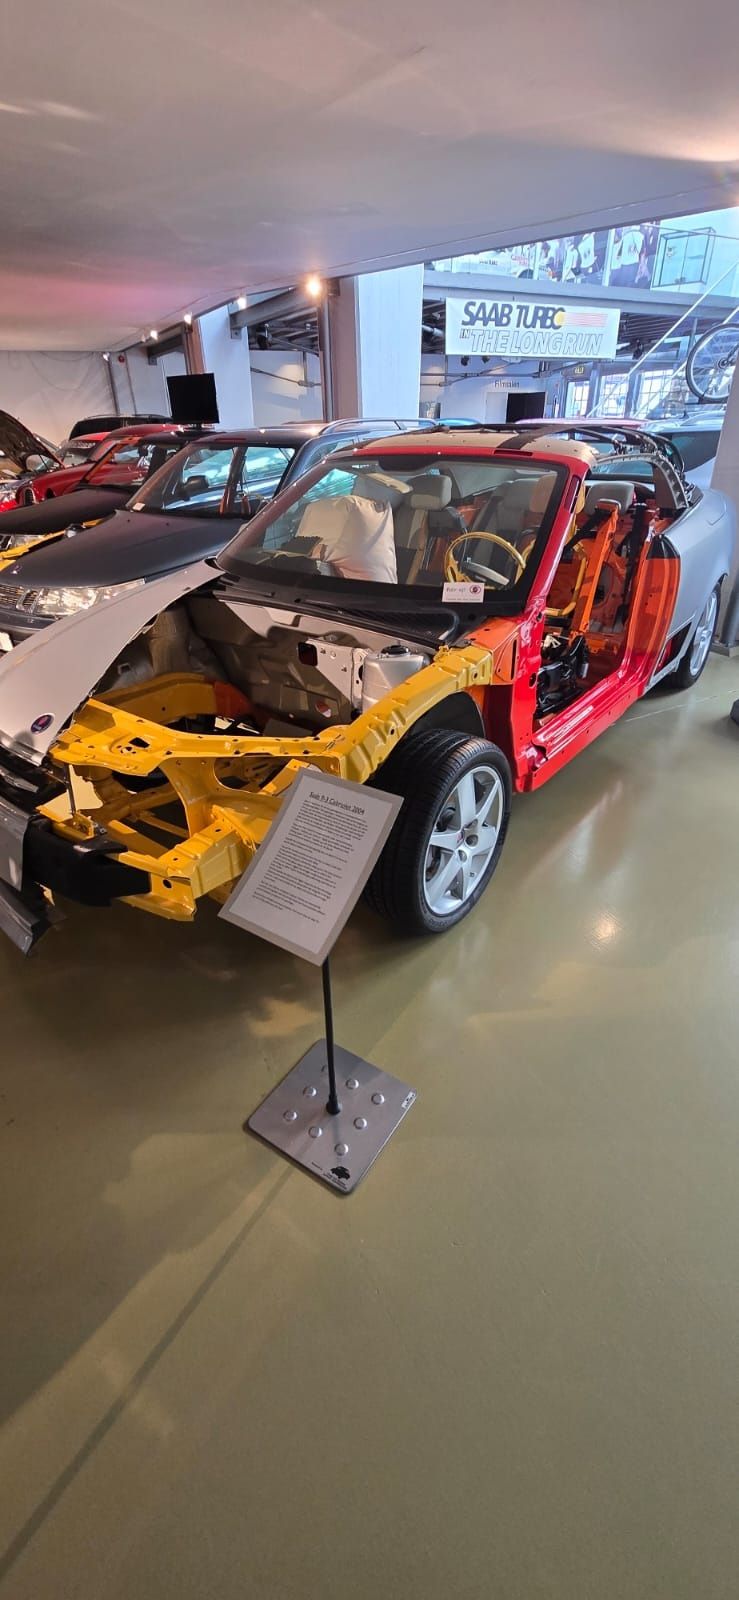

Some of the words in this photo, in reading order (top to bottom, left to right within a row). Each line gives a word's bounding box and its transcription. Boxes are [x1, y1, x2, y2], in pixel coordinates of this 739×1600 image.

[462, 301, 513, 327] SAAB
[516, 304, 566, 330] TURBO
[459, 328, 471, 339] IN
[472, 330, 510, 353] THE
[509, 330, 563, 355] LONG
[562, 332, 604, 356] RUN
